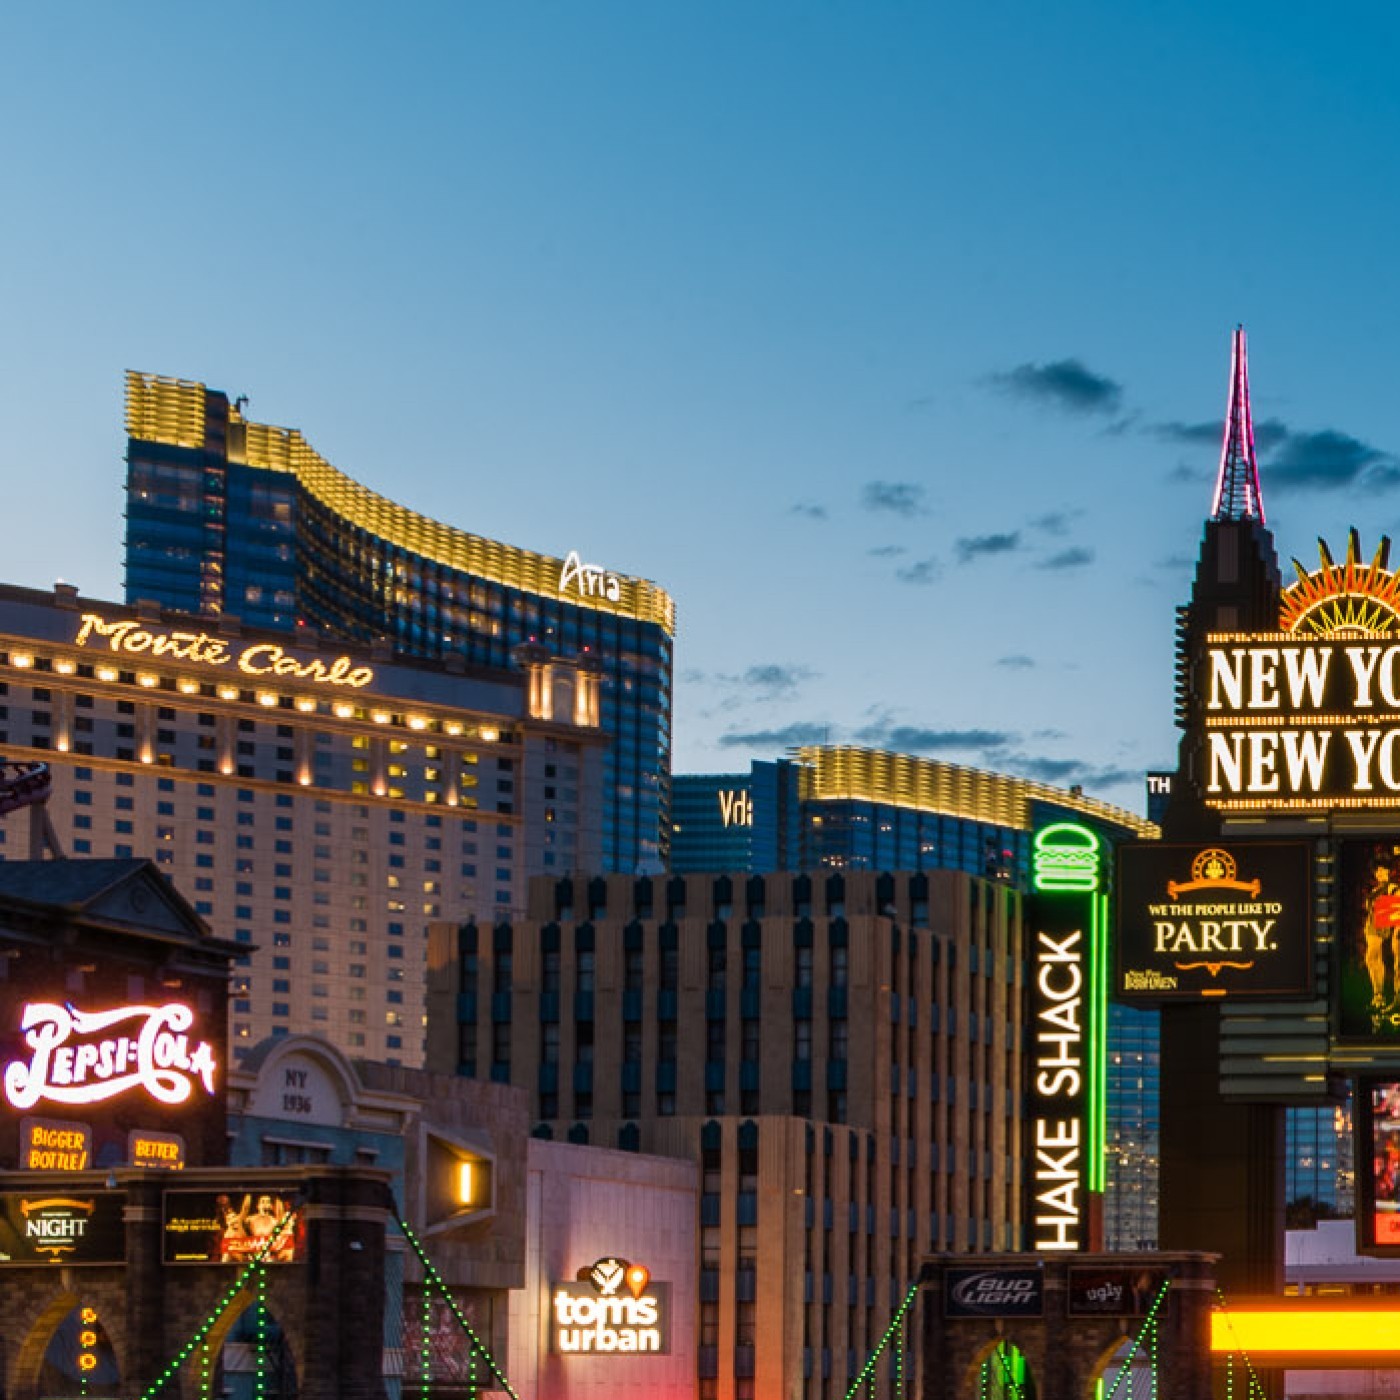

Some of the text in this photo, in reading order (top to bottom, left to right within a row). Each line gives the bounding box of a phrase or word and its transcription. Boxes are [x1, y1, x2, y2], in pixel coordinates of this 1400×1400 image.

[559, 551, 619, 601] Aria
[75, 614, 373, 687] Monte Carlo
[1208, 648, 1333, 710] NEW
[1207, 730, 1333, 792] NEW
[1148, 902, 1282, 916] WE THE PEOPLE LIKE TO
[1153, 919, 1278, 952] PARTY.
[1037, 930, 1081, 1096] SHACK
[31, 1127, 84, 1150] BIGGER
[135, 1139, 179, 1159] BETTER
[1035, 1118, 1079, 1250] HAKE
[26, 1218, 88, 1236] NIGHT
[963, 1291, 1037, 1304] LIGHT
[976, 1279, 1034, 1291] BUD
[555, 1291, 658, 1324] toms
[560, 1323, 660, 1350] urban
